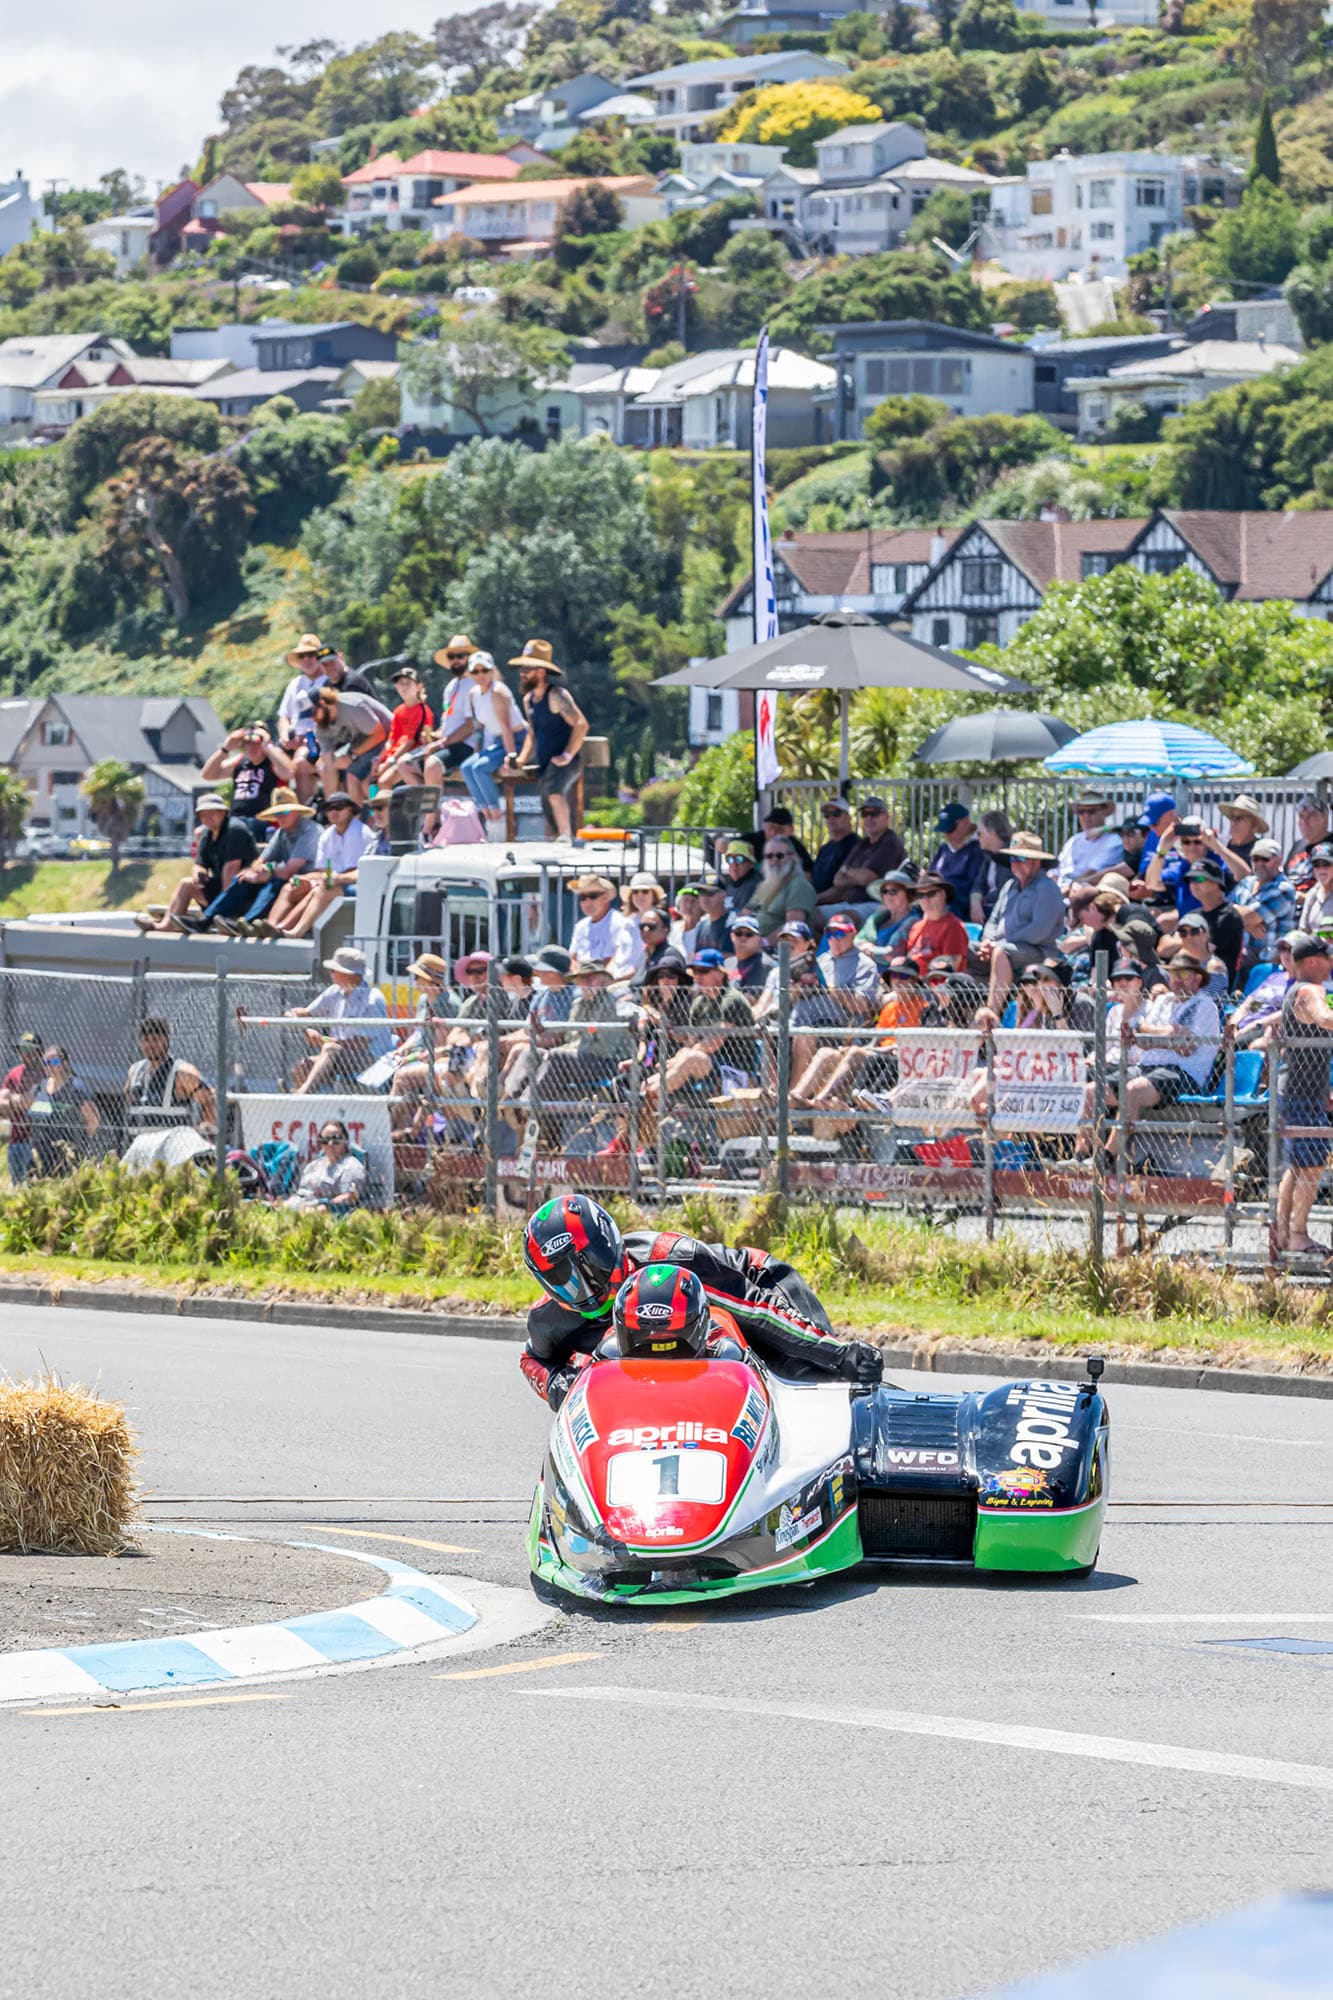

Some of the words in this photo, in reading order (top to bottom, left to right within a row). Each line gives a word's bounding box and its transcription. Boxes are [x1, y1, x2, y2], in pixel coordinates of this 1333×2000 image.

[234, 783, 260, 800] 23
[541, 1236, 571, 1255] X-lite
[639, 1304, 671, 1317] X-lite
[607, 1421, 728, 1446] aprilia
[1006, 1381, 1080, 1469] aprilia
[887, 1451, 958, 1464] WFD
[652, 1455, 680, 1495] 1
[645, 1526, 684, 1537] aprilia
